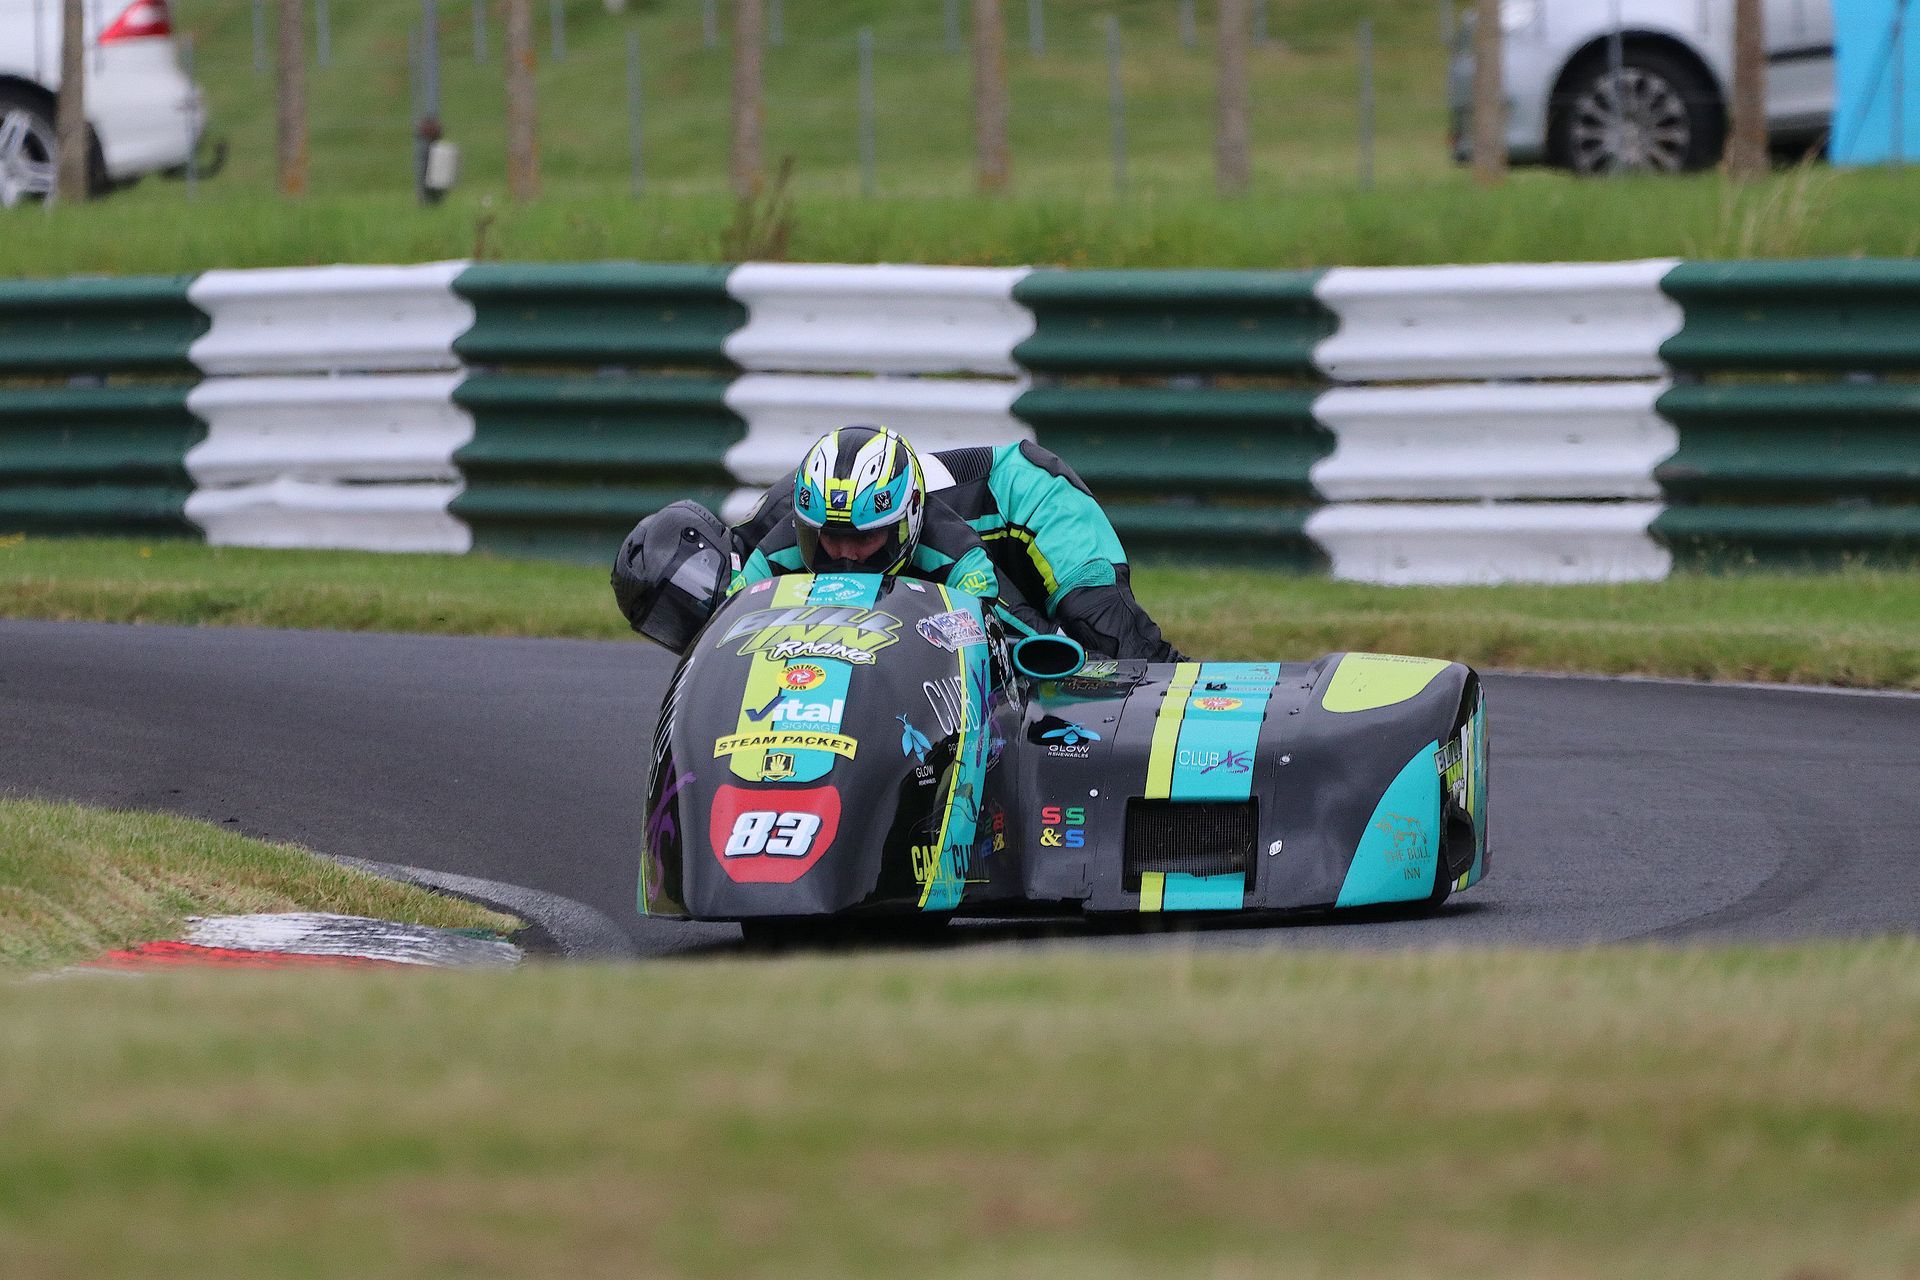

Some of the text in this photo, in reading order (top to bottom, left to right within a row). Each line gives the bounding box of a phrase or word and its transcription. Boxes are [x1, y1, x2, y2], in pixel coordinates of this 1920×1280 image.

[716, 605, 903, 648] BULL
[737, 622, 899, 655] INN
[772, 641, 873, 664] RACING
[780, 722, 839, 733] SIGNAGE
[718, 736, 853, 752] STEAM PACKET
[1048, 744, 1090, 753] GLOW
[1179, 750, 1219, 766] CLUB
[915, 764, 934, 778] GLOW
[724, 811, 823, 858] 83
[1404, 866, 1421, 880] INN
